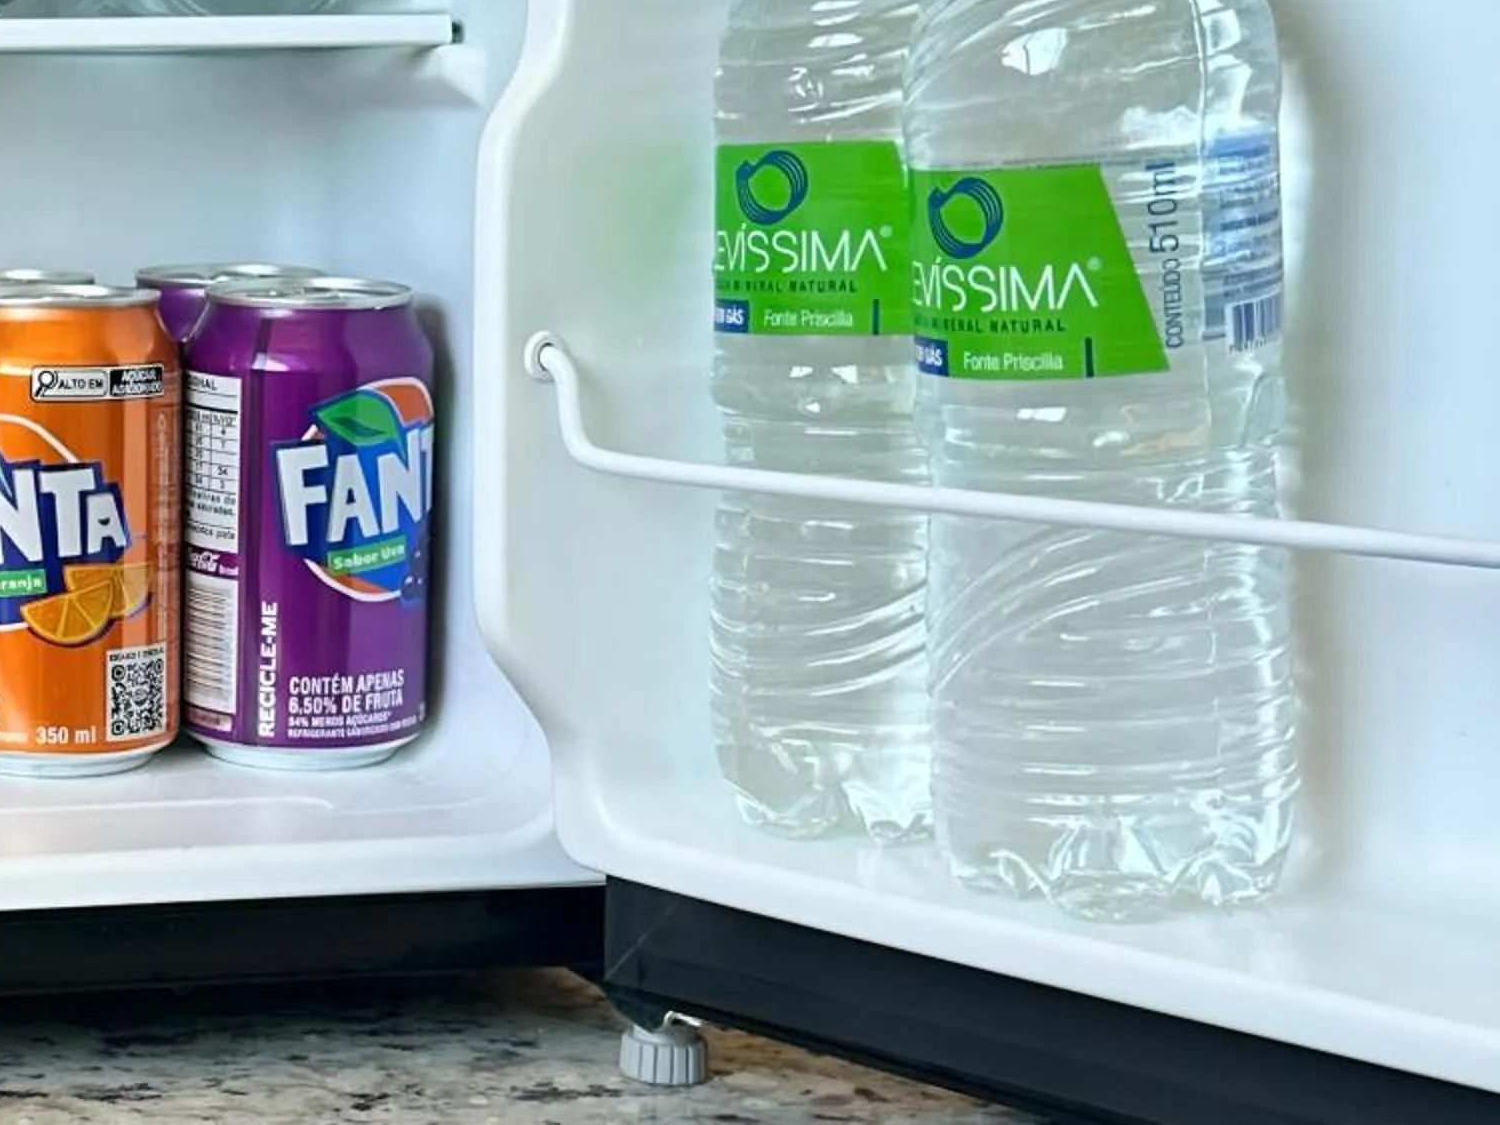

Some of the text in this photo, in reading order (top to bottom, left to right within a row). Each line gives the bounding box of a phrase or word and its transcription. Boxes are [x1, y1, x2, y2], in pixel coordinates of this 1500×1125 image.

[714, 222, 890, 274] EVÍSSIMA
[788, 279, 858, 294] NATURAL
[911, 256, 1100, 313] EVÍSSIMA
[763, 308, 798, 327] Fonte
[989, 318, 1067, 334] NATURAL
[962, 350, 1000, 371] Fonte
[57, 378, 104, 391] ALTO EM
[276, 426, 435, 546] FANT
[333, 543, 405, 571] Sabor Uva
[257, 600, 279, 739] RECICLE-ME
[288, 668, 405, 695] CONTÉM APENAS
[287, 688, 404, 716] 6,50% DE FRUTA
[35, 725, 69, 745] 350
[74, 725, 97, 745] ml
